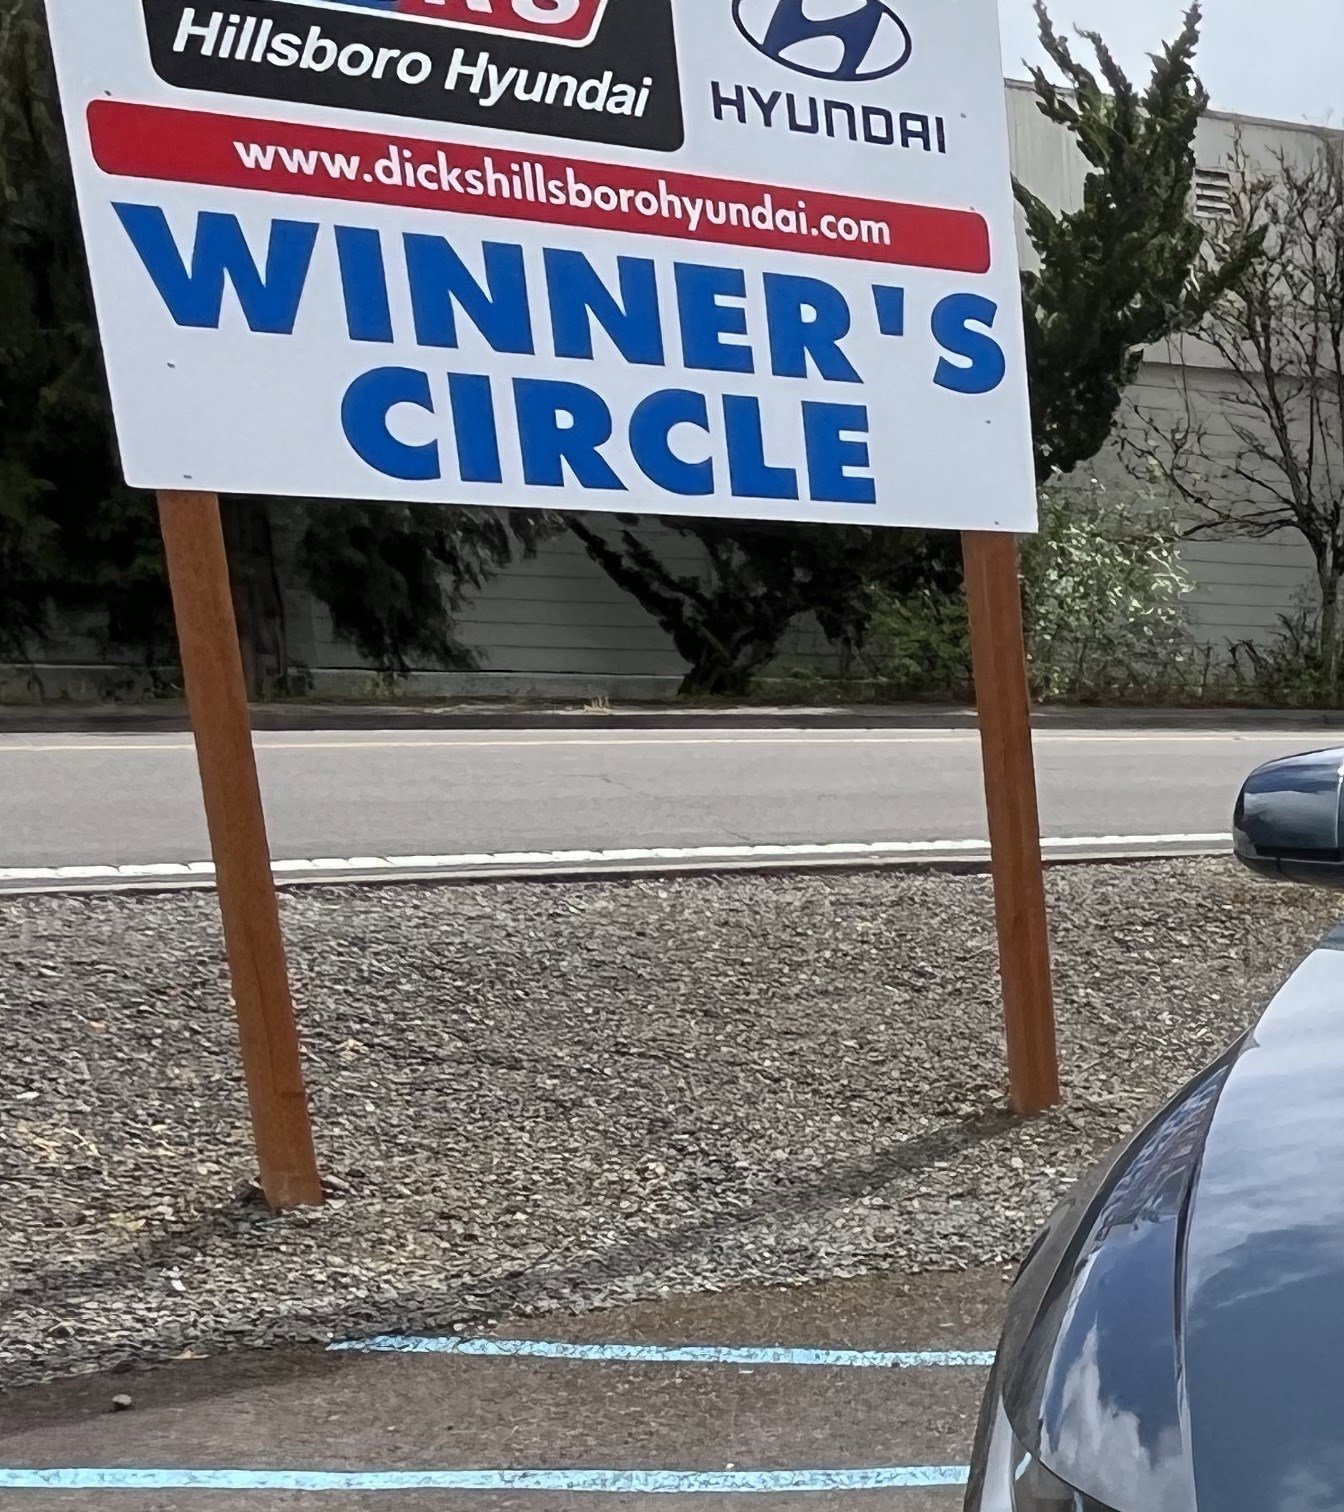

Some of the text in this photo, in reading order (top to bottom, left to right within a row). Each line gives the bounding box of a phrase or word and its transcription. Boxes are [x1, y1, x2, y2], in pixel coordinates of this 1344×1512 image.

[171, 6, 653, 118] Hillsboro Hyundai
[711, 80, 946, 155] HYUNDAI
[233, 138, 891, 247] www.dickshillsborohyundai.com
[111, 201, 1006, 395] WINNER'S
[340, 366, 877, 505] CIRCLE
